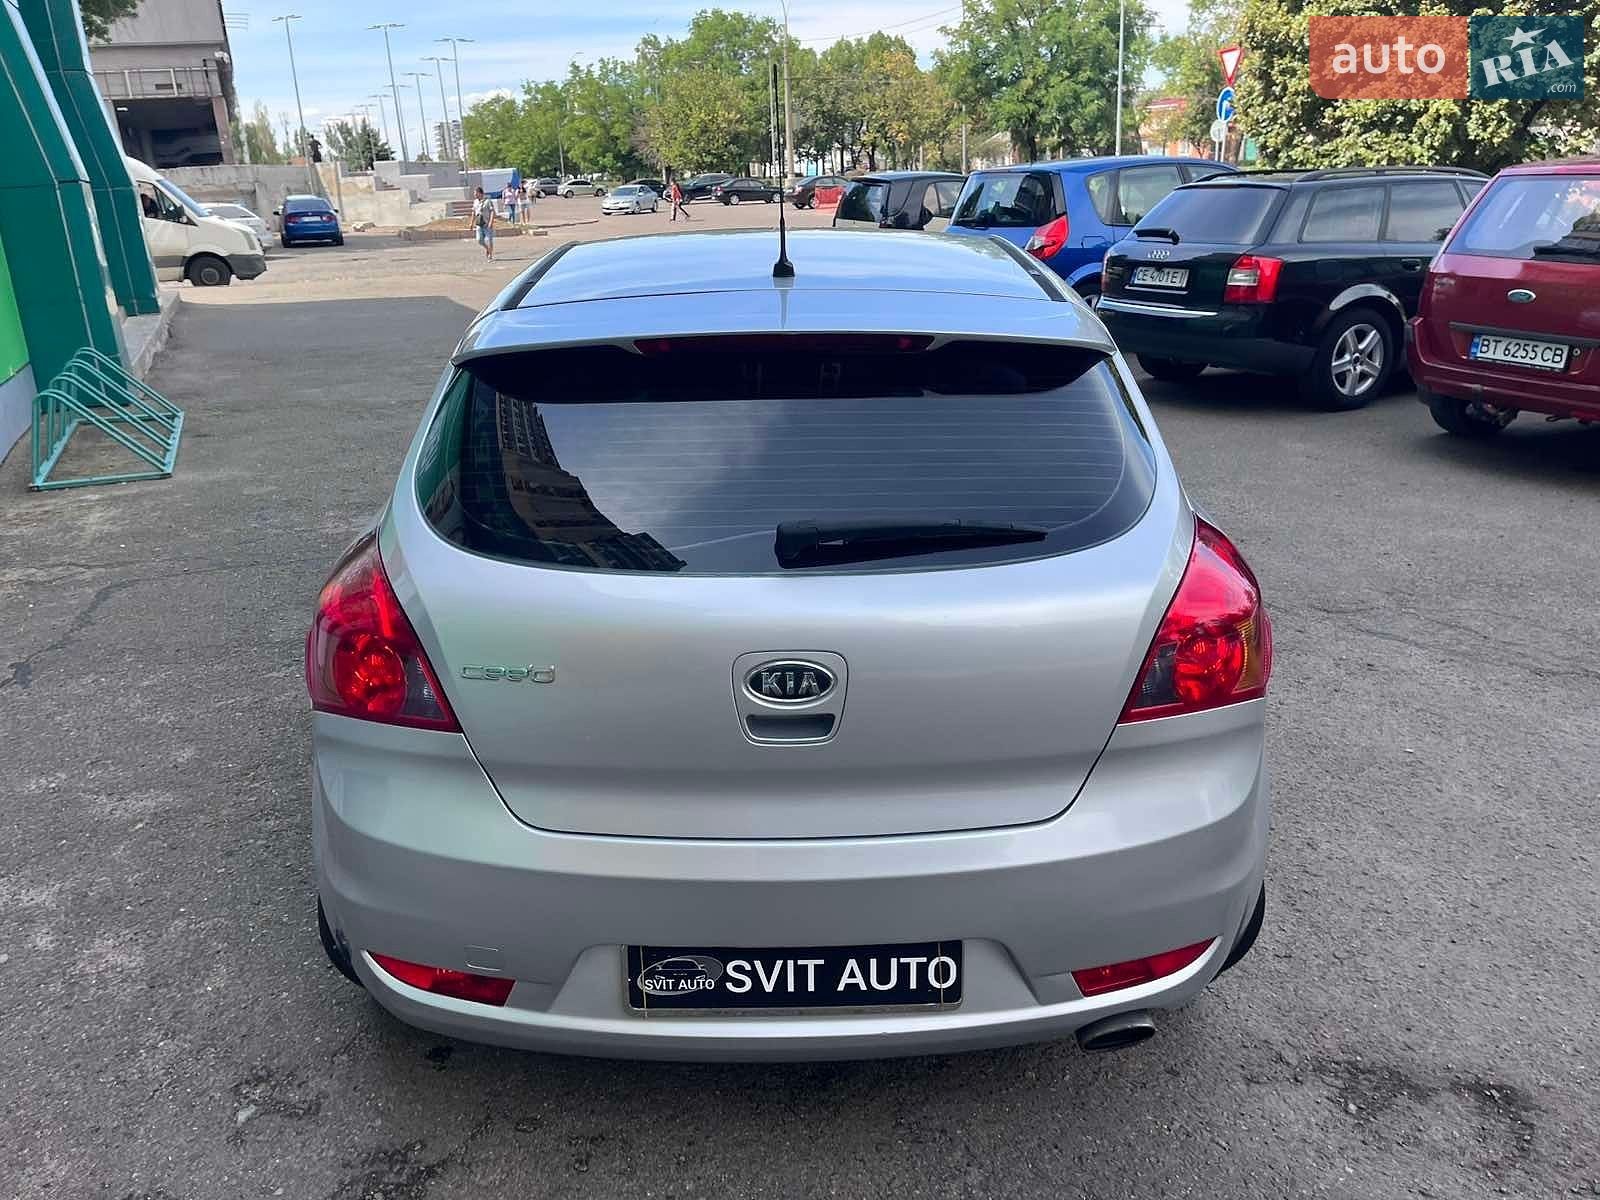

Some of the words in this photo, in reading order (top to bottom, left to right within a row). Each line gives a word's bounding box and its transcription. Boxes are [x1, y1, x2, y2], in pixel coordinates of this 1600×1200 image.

[1479, 338, 1502, 356] BT
[1503, 341, 1539, 361] 6255
[1541, 346, 1564, 364] CB
[761, 671, 821, 697] KIA
[645, 979, 675, 990] SVIT
[678, 978, 715, 990] AUTO
[725, 959, 825, 993] SVIT
[836, 956, 958, 992] AUTO
